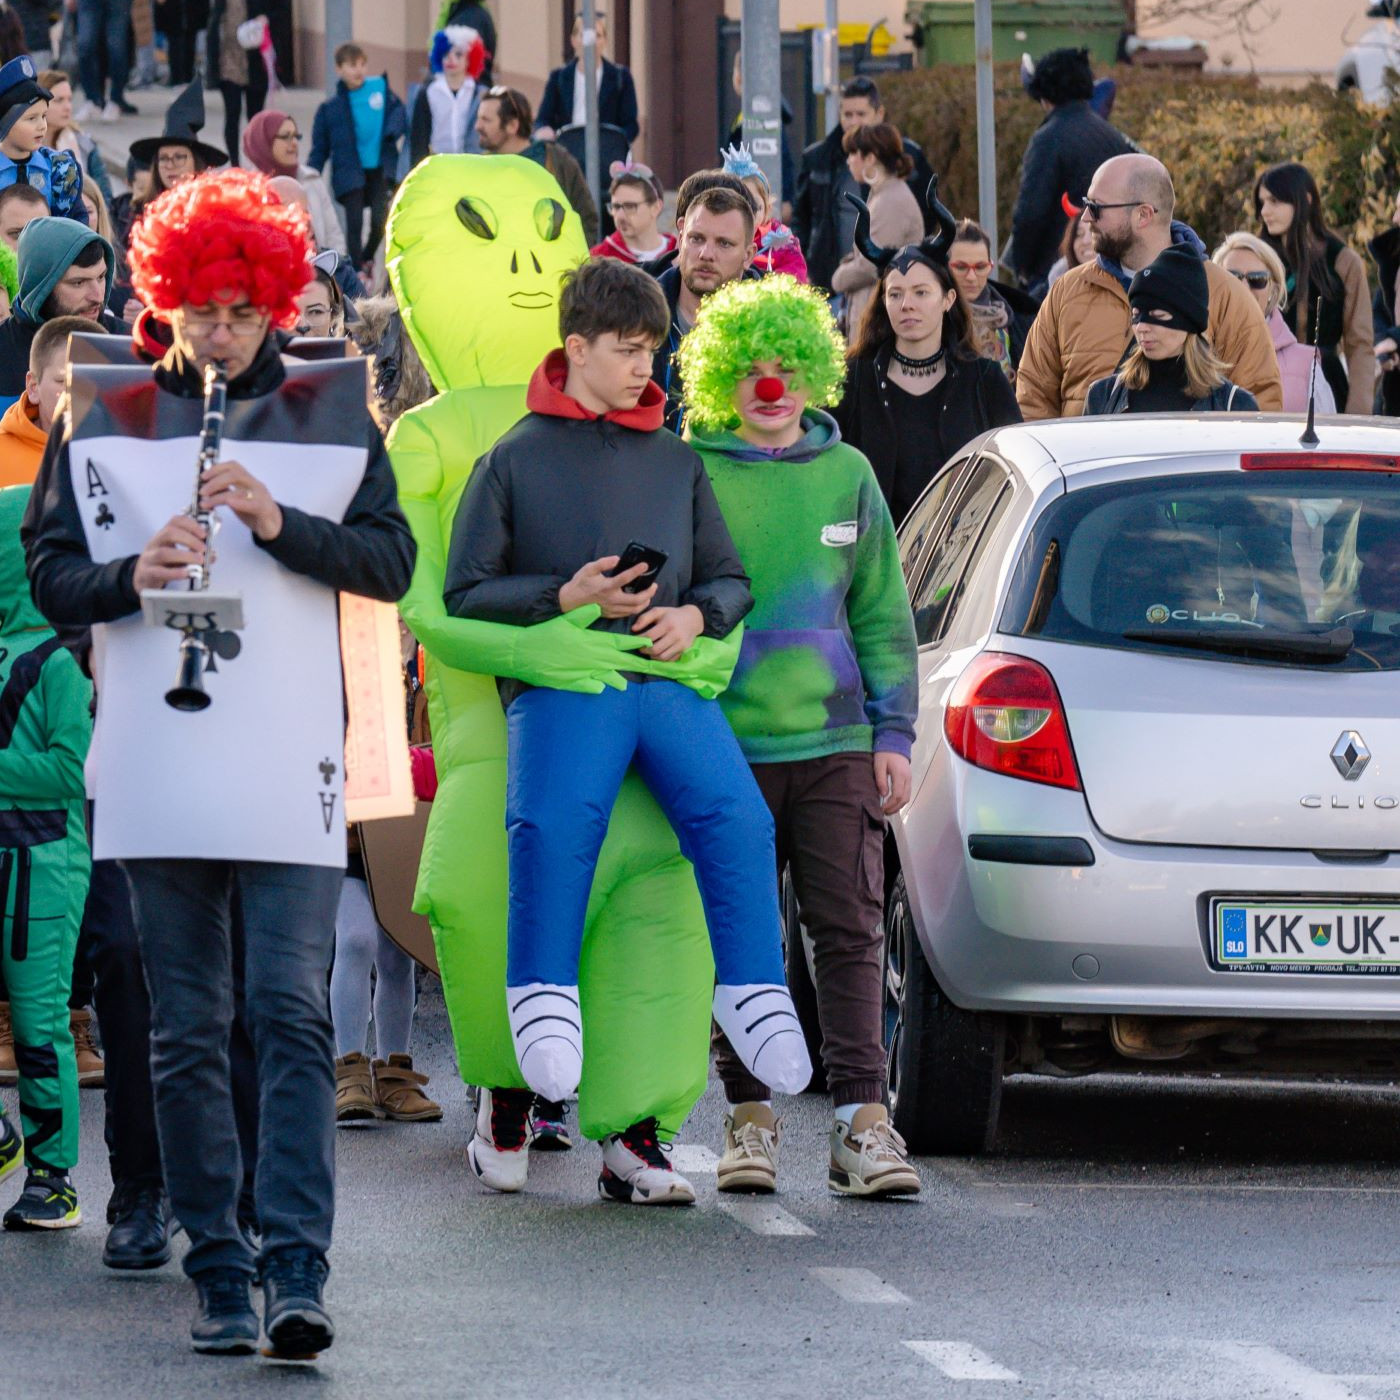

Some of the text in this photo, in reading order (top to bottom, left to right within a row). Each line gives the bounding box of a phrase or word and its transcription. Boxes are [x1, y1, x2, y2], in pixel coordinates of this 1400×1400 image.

[86, 458, 108, 498] A
[318, 791, 337, 835] A
[1299, 793, 1400, 810] CLIO
[1226, 940, 1245, 953] SLO
[1254, 914, 1304, 954] KK
[1270, 964, 1288, 972] NOVO
[1289, 964, 1311, 972] MESTO
